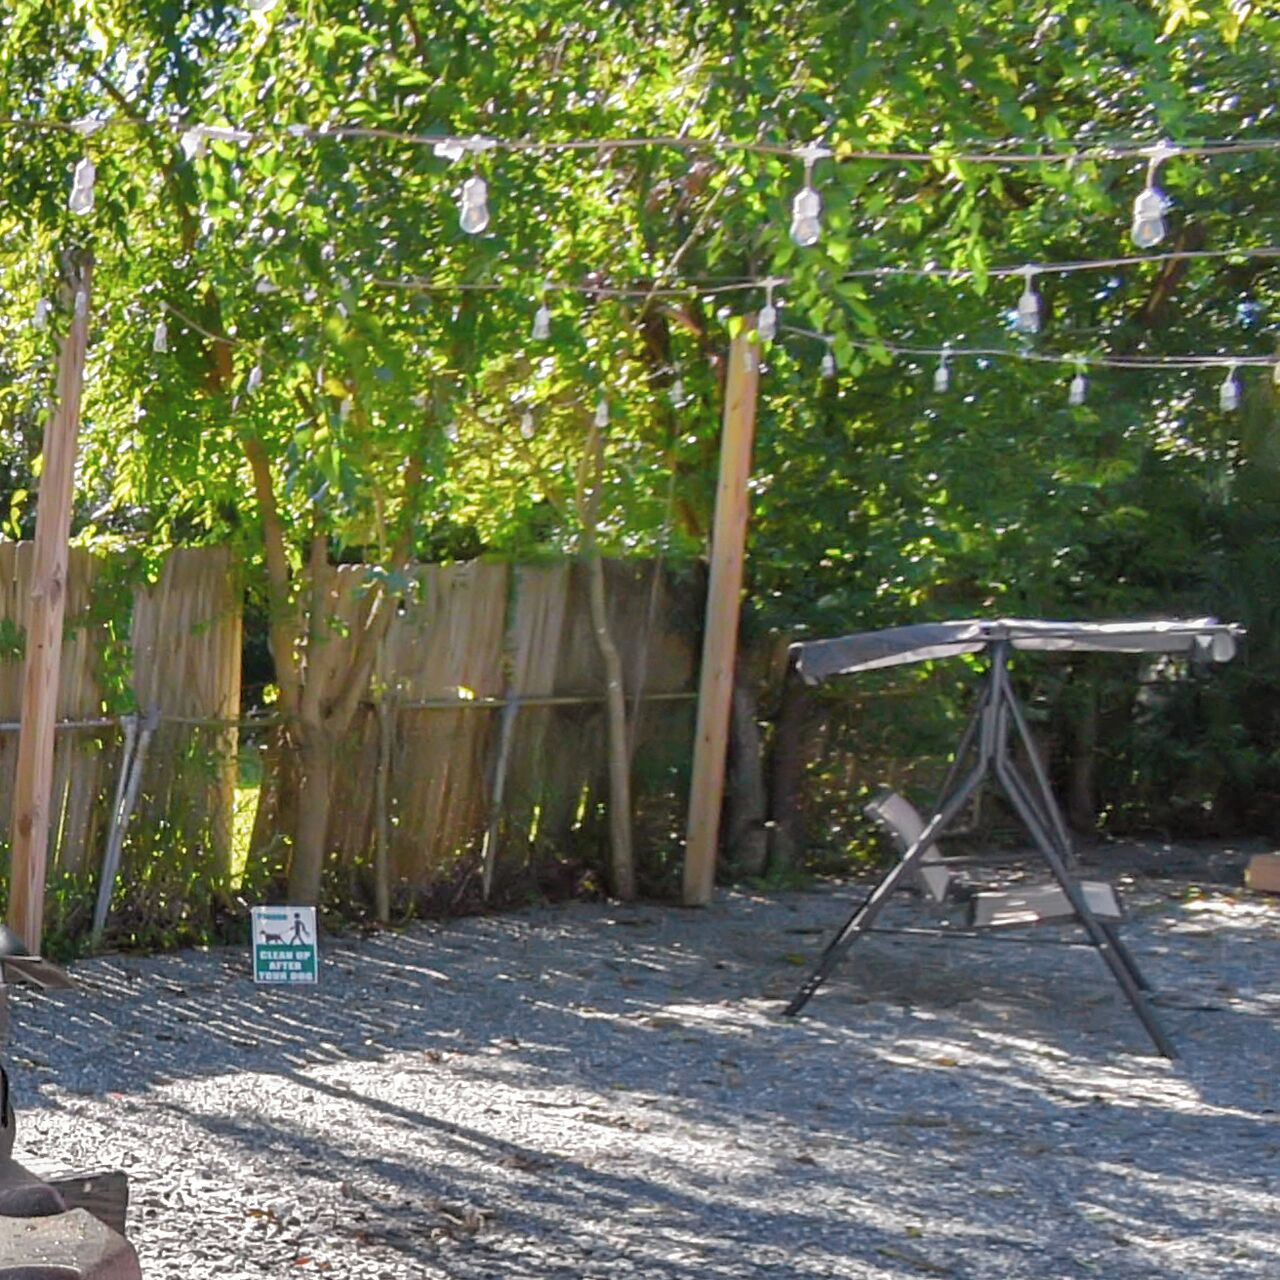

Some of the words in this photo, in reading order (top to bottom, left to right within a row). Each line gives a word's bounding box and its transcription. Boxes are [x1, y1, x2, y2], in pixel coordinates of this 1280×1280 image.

[259, 951, 293, 960] CLEAN
[269, 961, 302, 970] AFTER
[259, 971, 287, 980] YOUR
